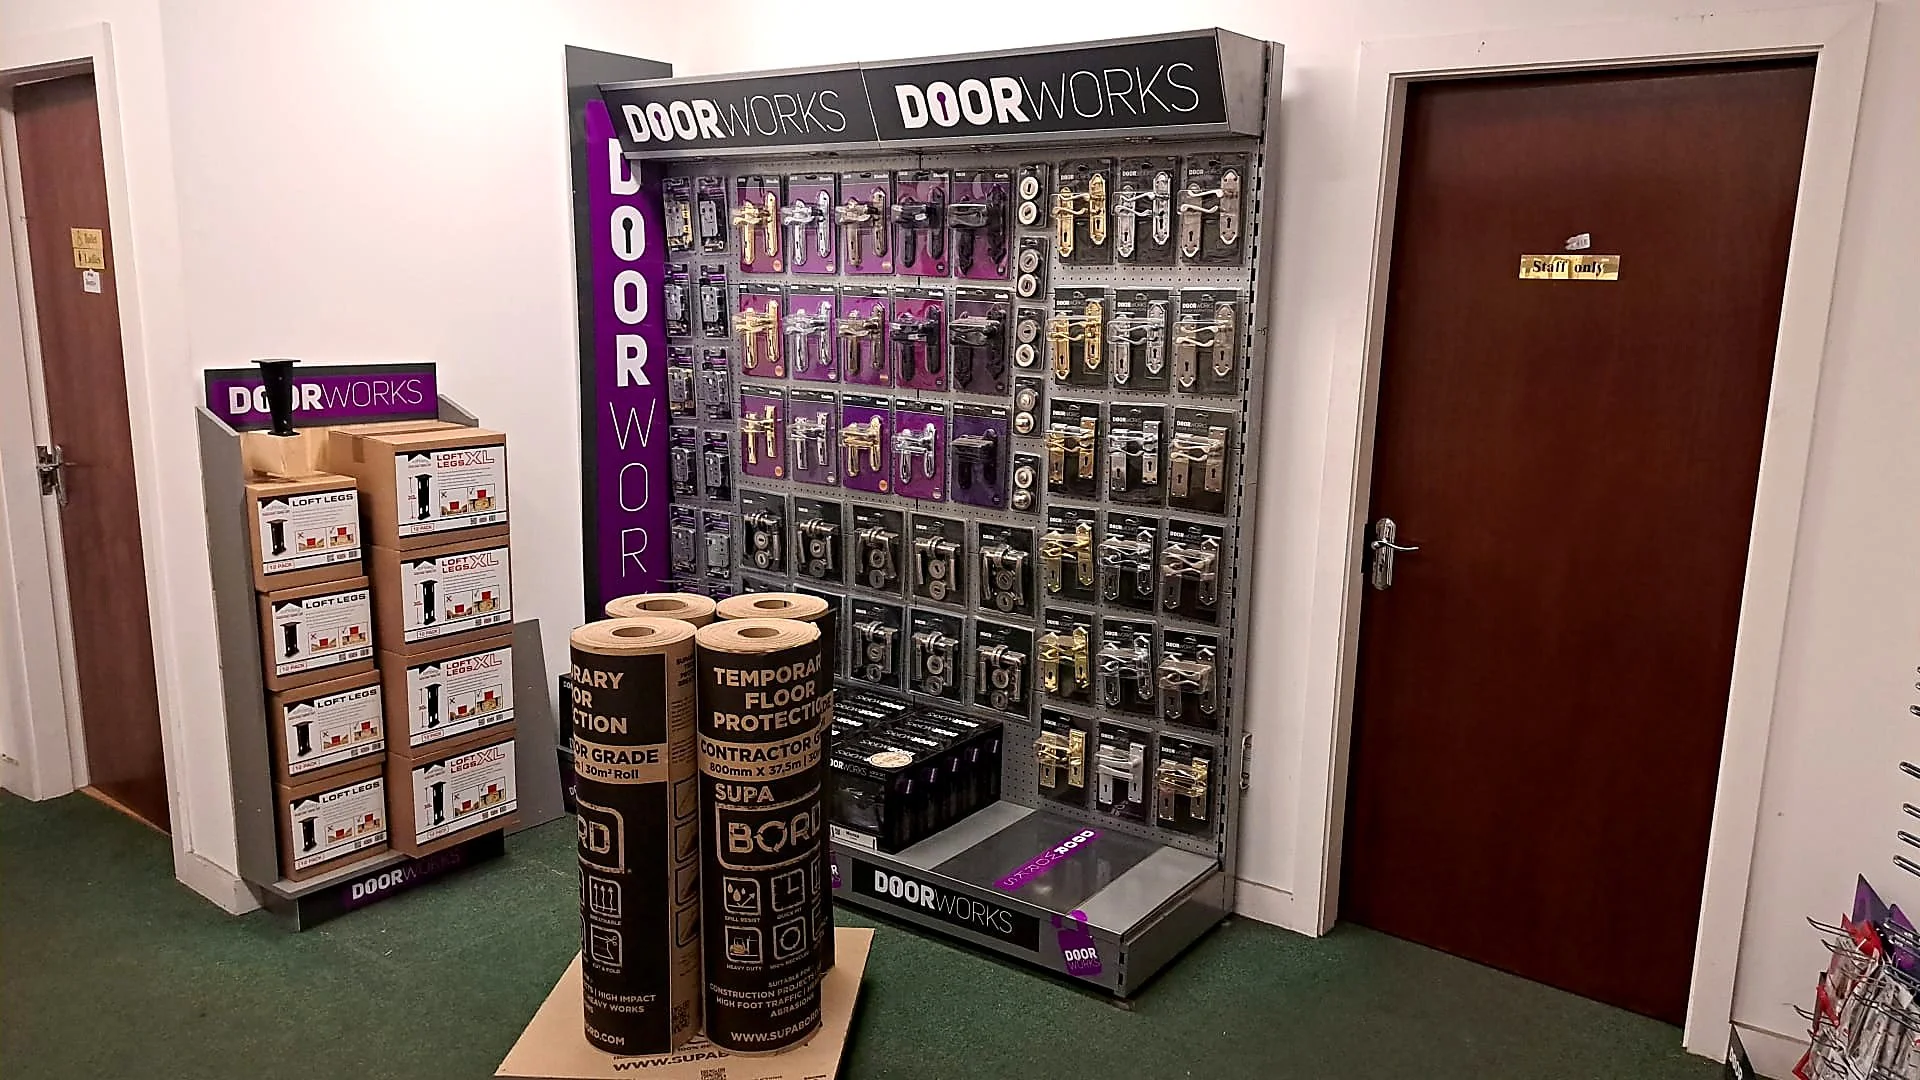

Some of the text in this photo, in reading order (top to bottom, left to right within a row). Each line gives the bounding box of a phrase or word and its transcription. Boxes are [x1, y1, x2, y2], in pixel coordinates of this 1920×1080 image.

[895, 63, 1199, 129] DOORWORKS
[622, 90, 846, 143] DOORWORKS
[1532, 259, 1604, 277] Staff only
[437, 450, 495, 466] LOFT XL
[437, 460, 464, 468] LEGS
[292, 493, 354, 507] LOFT LEGS
[442, 553, 499, 569] LOFT XL
[442, 564, 470, 573] LEGS
[306, 593, 366, 609] LOFT LEGS
[447, 653, 502, 671] LOFT XL
[447, 666, 473, 676] LEGS
[572, 663, 624, 689] RARY
[317, 689, 377, 708] LOFT LEGS
[745, 680, 815, 710] FLOOR
[451, 747, 505, 766] LOFT XL
[591, 748, 659, 765] GRADE
[701, 736, 811, 762] CONTRACTOR
[451, 761, 477, 773] LEGS
[614, 769, 639, 780] Roll
[710, 762, 753, 776] 800mm
[756, 766, 765, 777] X
[768, 759, 802, 776] 37.5m
[322, 781, 380, 803] LOFT LEGS
[715, 782, 775, 803] SUPA
[1004, 830, 1095, 886] DOORWORKS
[874, 870, 1013, 935] DOORWORKS
[1065, 947, 1098, 961] DOOR
[727, 963, 745, 971] HEAVY
[1067, 960, 1100, 970] WORKS
[598, 990, 618, 1002] HIGH
[619, 994, 657, 1004] IMPACT
[709, 983, 775, 999] CONSTRUCTION
[716, 990, 804, 1009] HIGH FOOT TRAFFIC
[609, 1004, 645, 1014] WORKS
